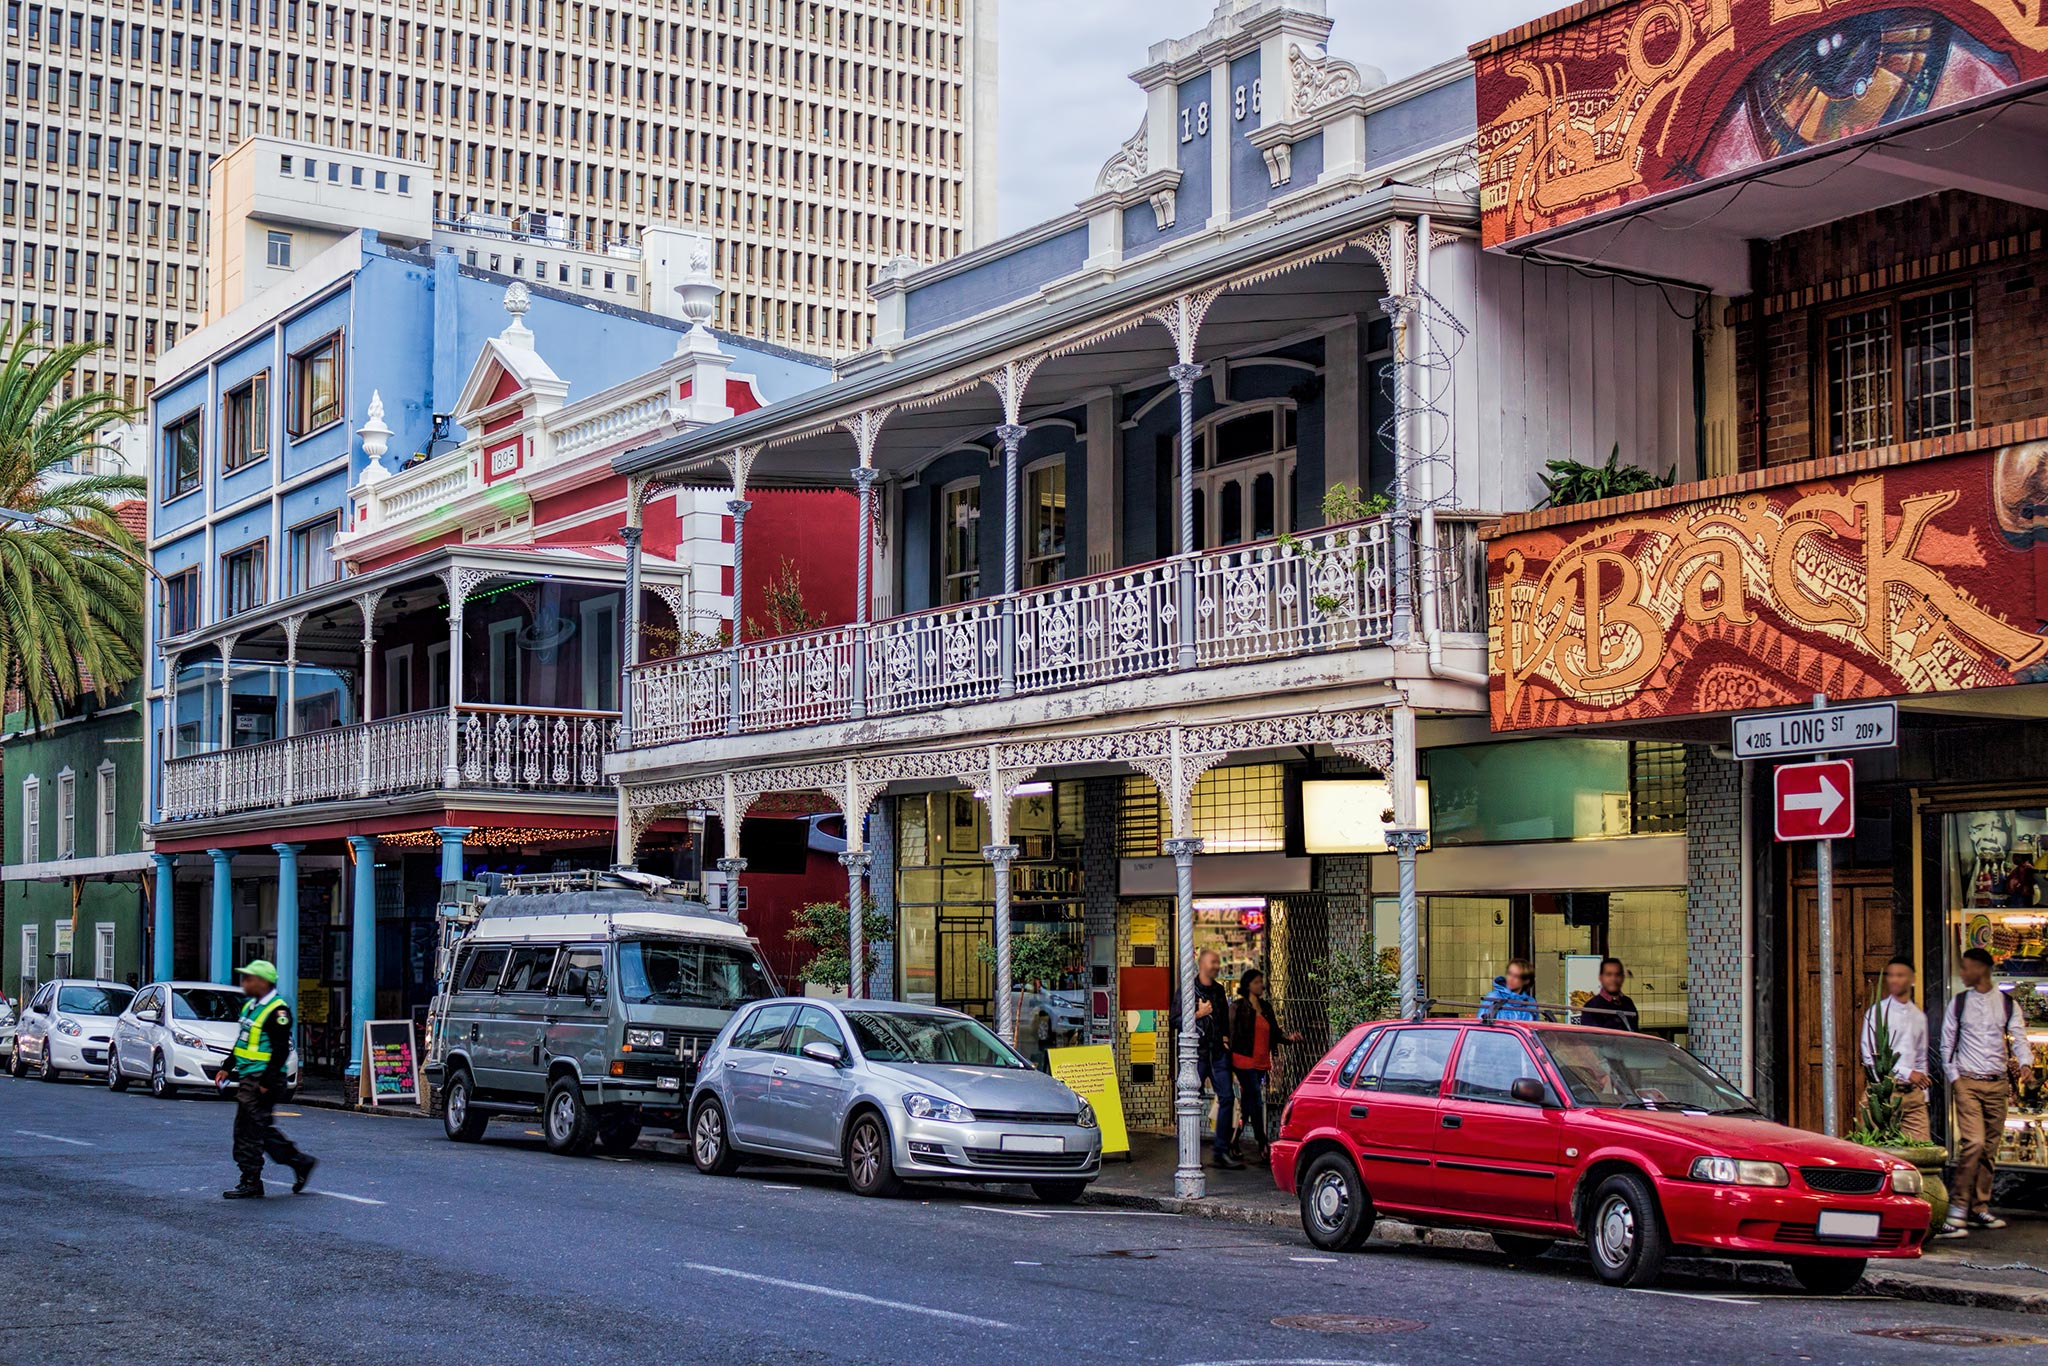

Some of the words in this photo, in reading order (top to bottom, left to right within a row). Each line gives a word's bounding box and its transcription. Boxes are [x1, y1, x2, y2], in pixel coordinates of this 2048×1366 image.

[494, 449, 514, 470] 1895
[1754, 732, 1772, 748] 205
[1780, 718, 1824, 746] LONG
[1832, 716, 1844, 732] ST
[1856, 723, 1874, 740] 209
